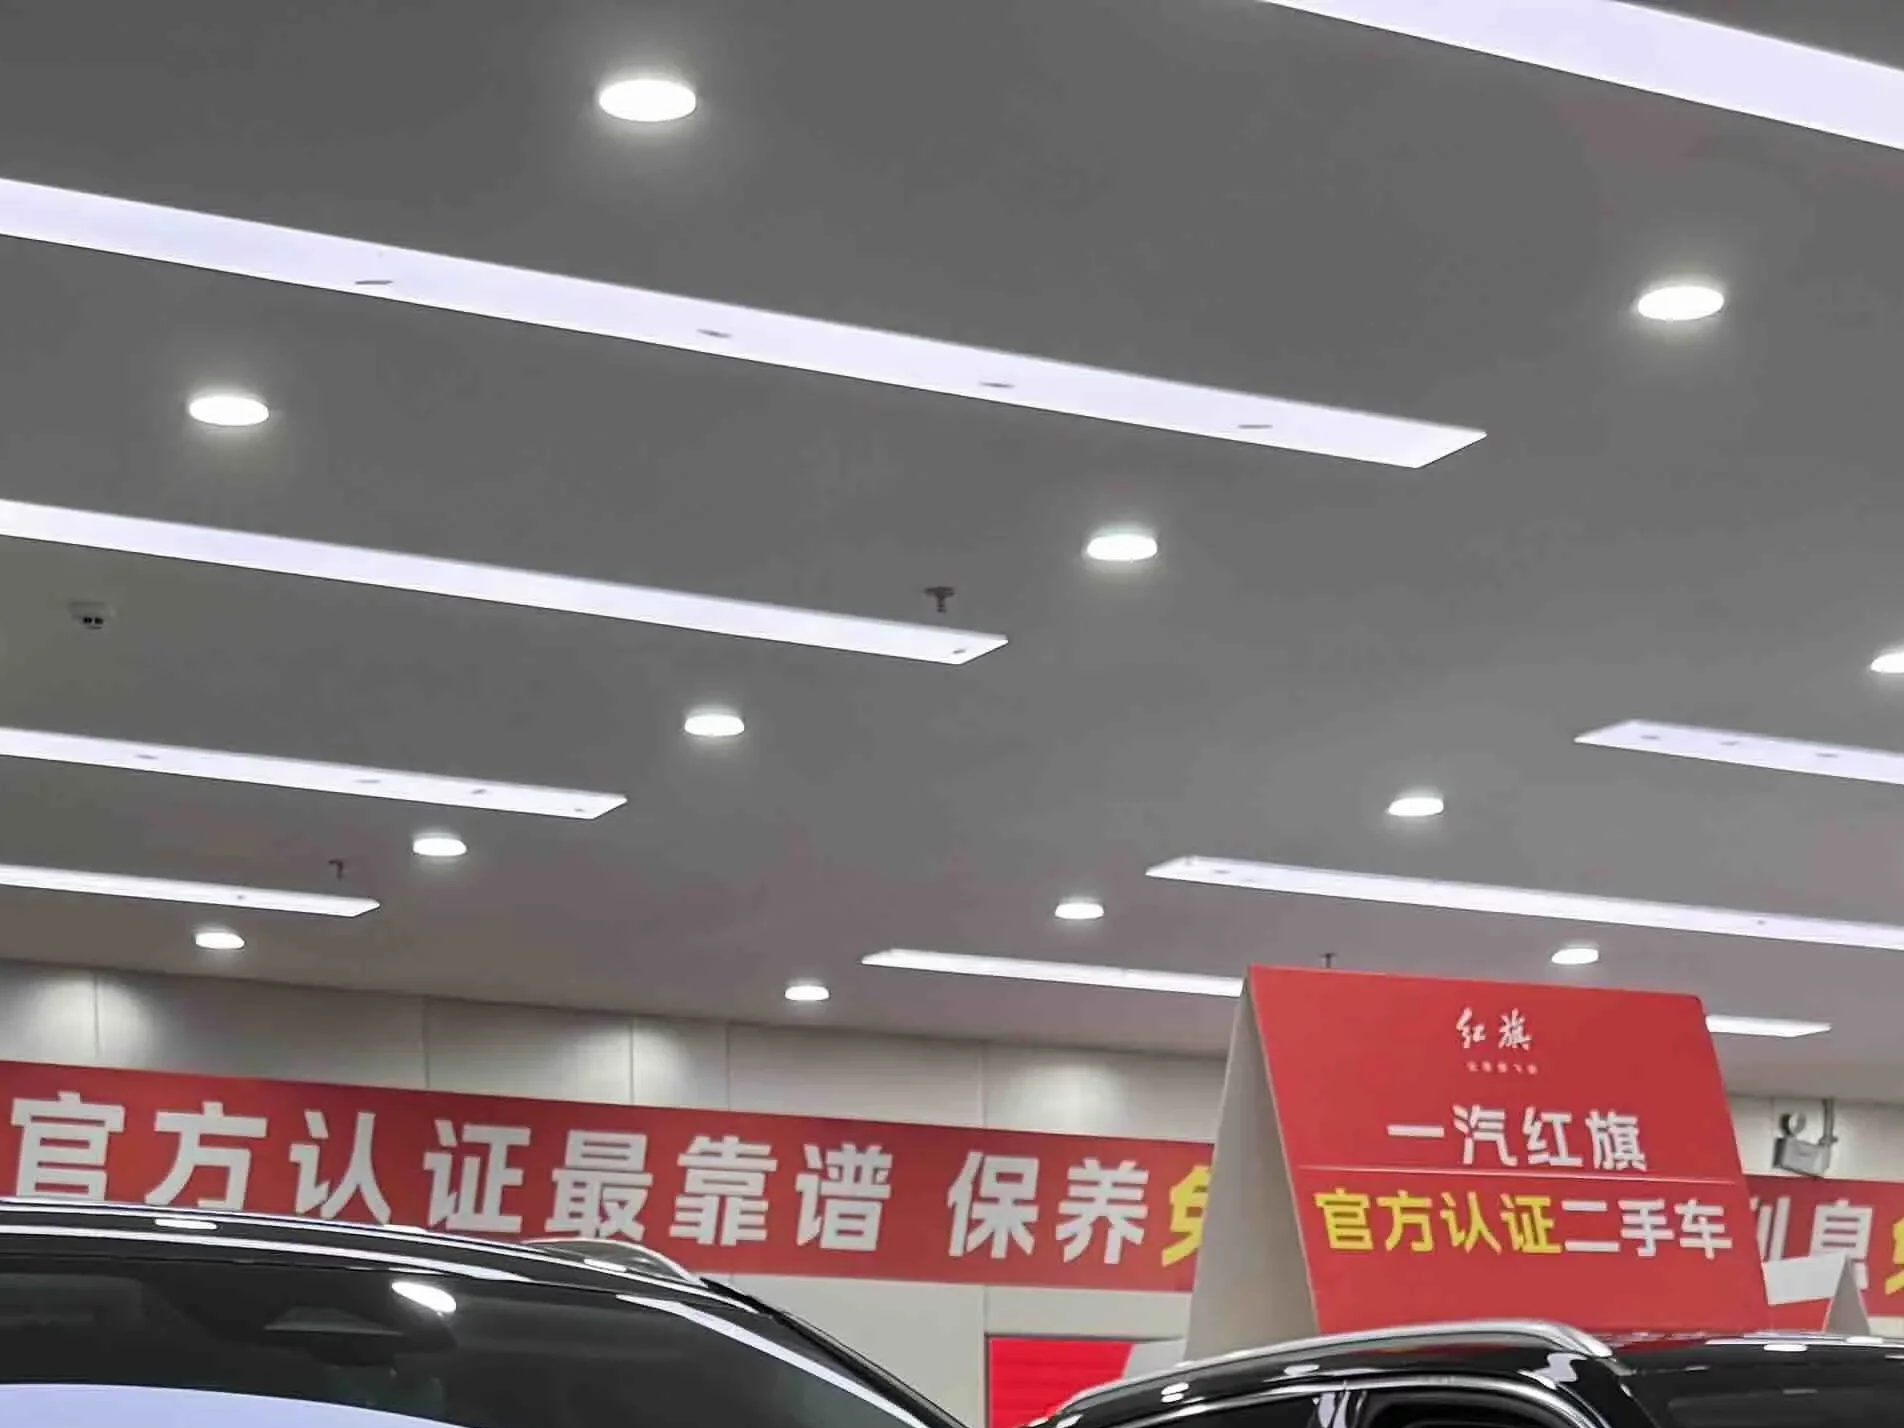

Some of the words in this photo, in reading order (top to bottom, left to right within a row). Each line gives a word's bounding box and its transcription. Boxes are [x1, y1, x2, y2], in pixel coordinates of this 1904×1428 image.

[1456, 1006, 1533, 1051] 红旗
[10, 1090, 893, 1252] 官方认证最靠谱
[1387, 1103, 1647, 1171] 一汽红旗
[1313, 1189, 1734, 1260] 官方认证二手车
